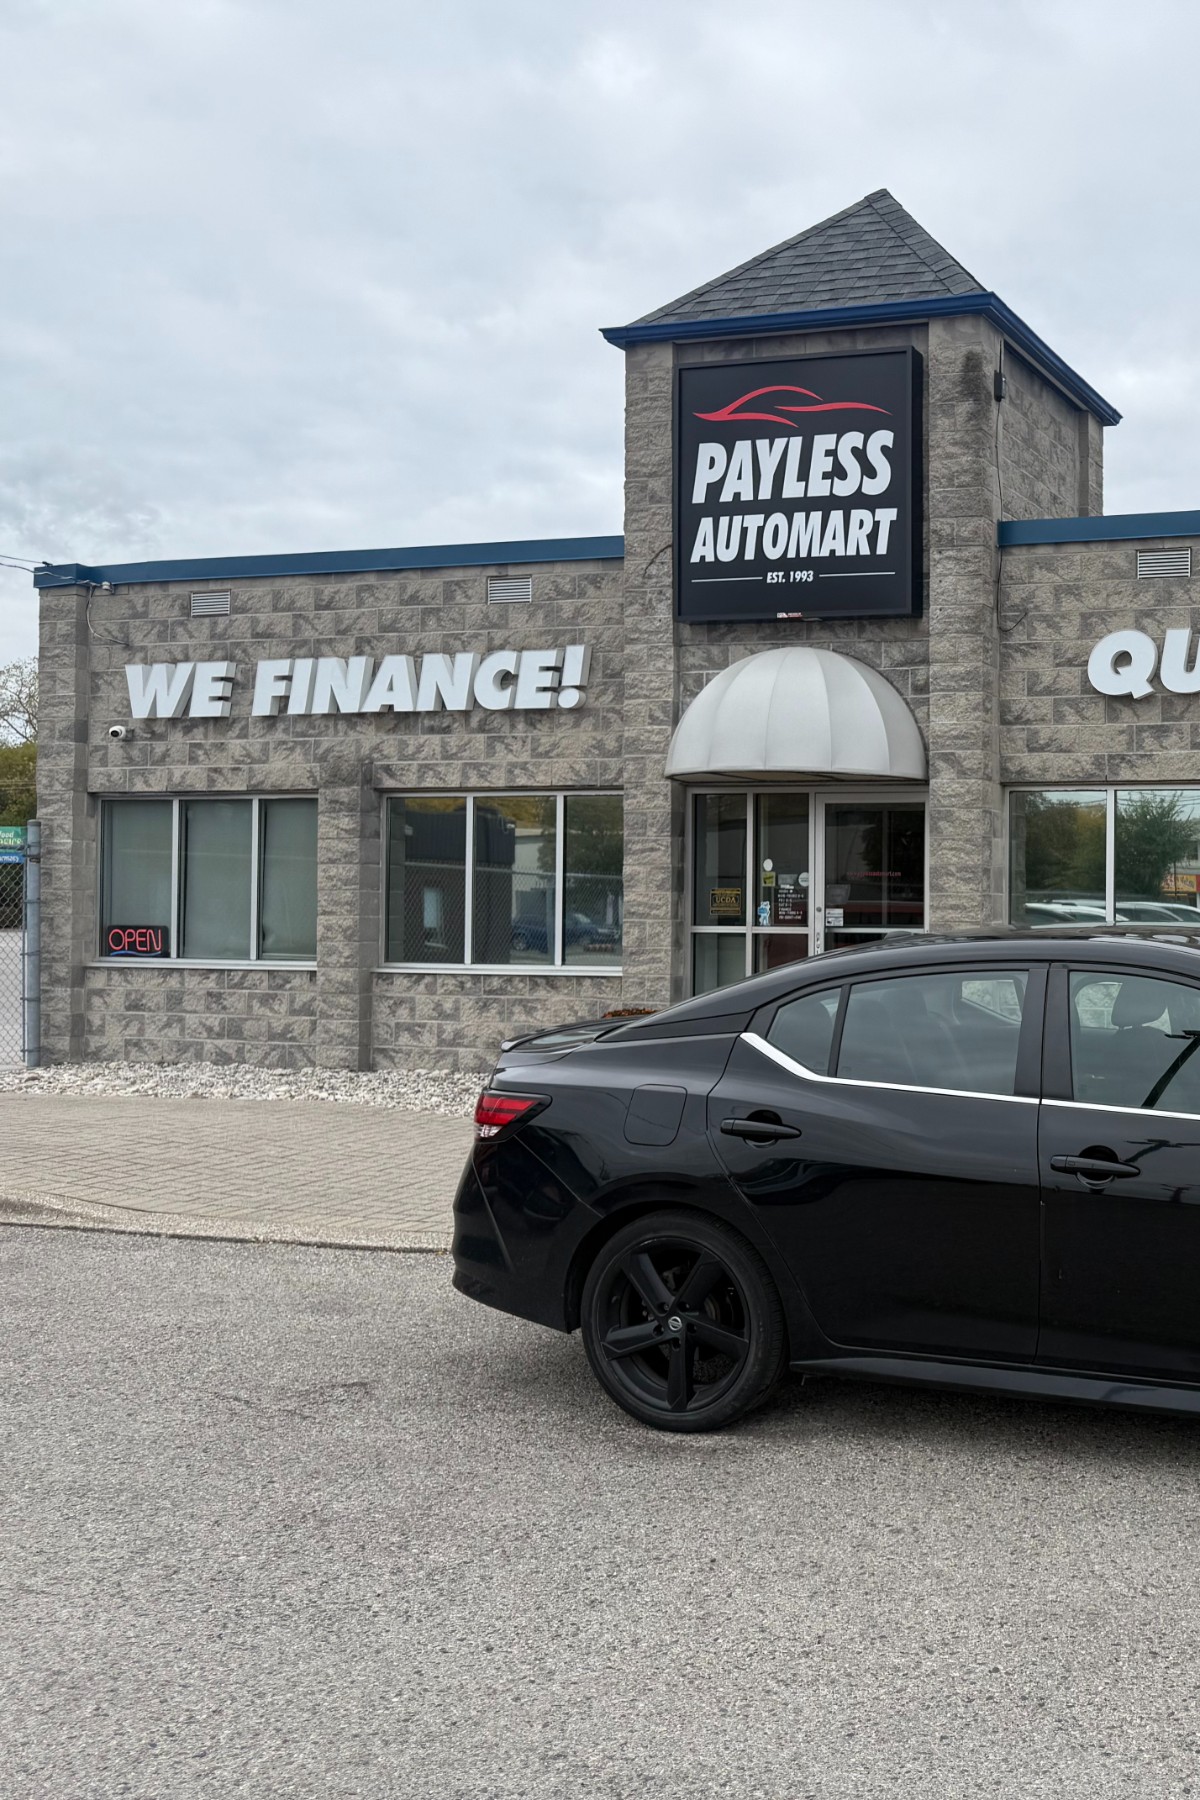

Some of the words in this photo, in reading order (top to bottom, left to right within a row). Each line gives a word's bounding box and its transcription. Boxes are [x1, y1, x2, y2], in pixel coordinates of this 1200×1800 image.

[692, 429, 894, 504] PAYLESS
[690, 508, 898, 563] AUTOMART
[766, 572, 785, 583] EST.
[789, 570, 814, 583] 1993
[124, 661, 237, 719] WE
[251, 644, 592, 716] FINANCE!
[109, 929, 162, 951] OPEN
